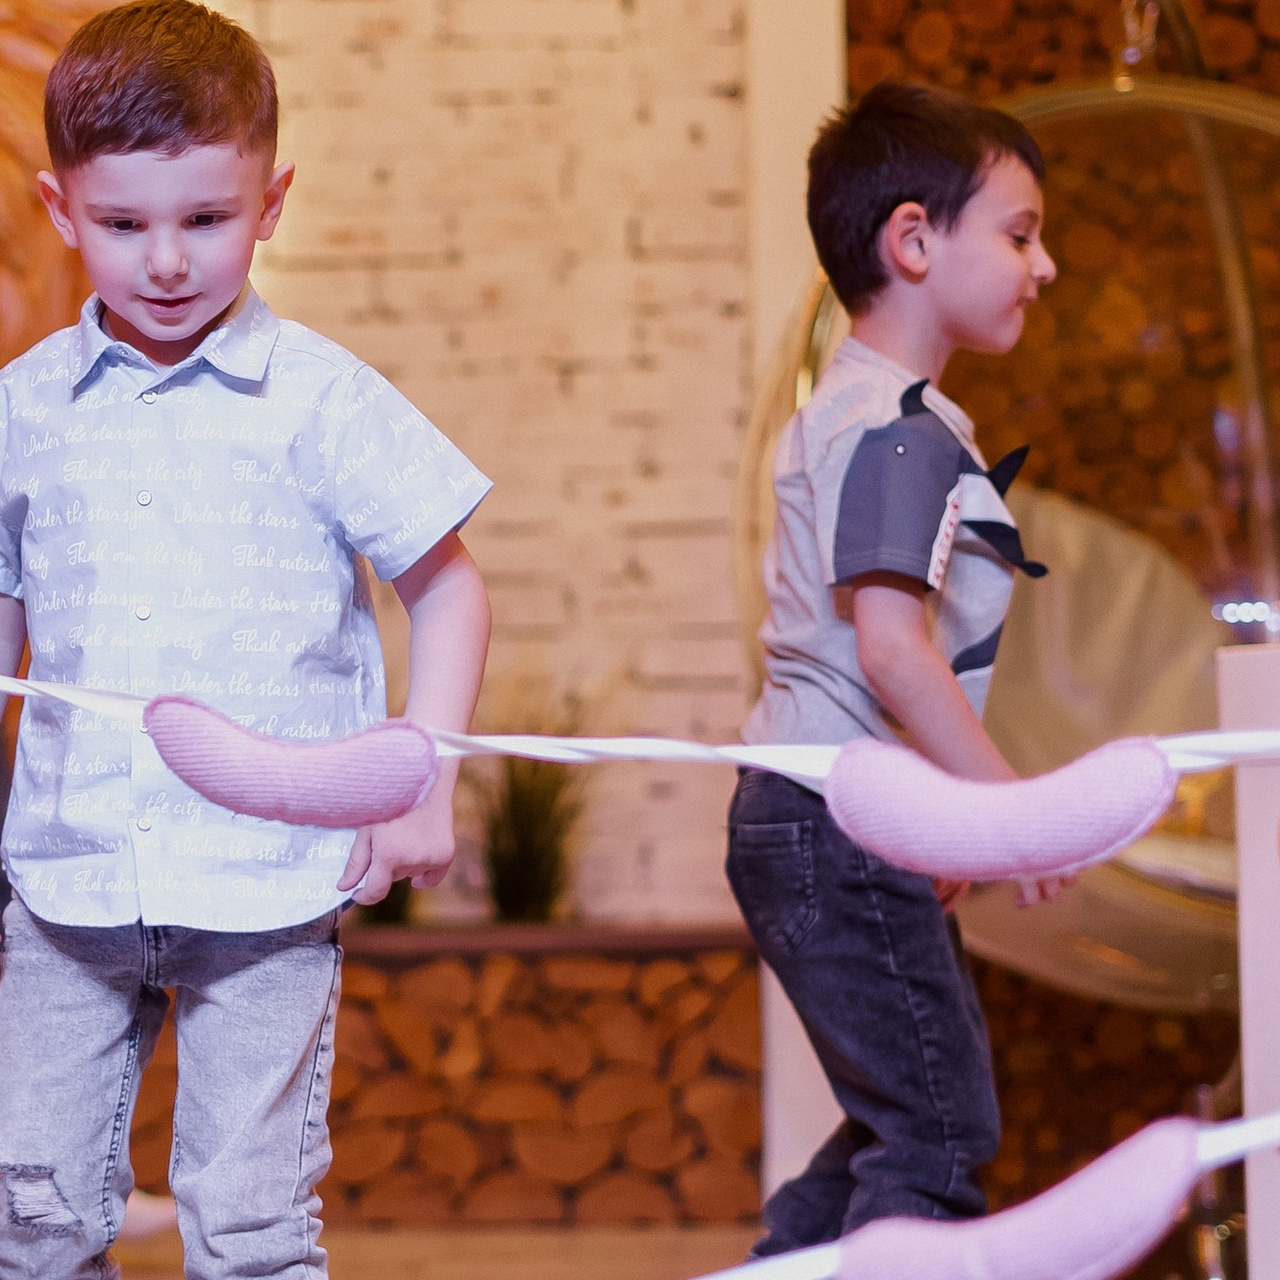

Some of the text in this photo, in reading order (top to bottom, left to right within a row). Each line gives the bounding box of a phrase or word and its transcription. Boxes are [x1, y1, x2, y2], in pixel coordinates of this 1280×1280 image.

[23, 430, 61, 458] Under
[64, 424, 87, 445] the
[174, 417, 225, 441] Under
[229, 421, 256, 442] the
[260, 426, 305, 447] stars
[63, 458, 112, 484] Think
[146, 458, 171, 482] the
[174, 460, 207, 492] city
[232, 458, 283, 485] Think
[24, 506, 64, 531] Under
[65, 499, 85, 524] the
[172, 500, 225, 524] Under
[228, 500, 255, 525] the
[257, 505, 301, 530] stars
[67, 539, 108, 566] Think
[144, 541, 172, 565] the
[173, 544, 207, 576] city
[232, 542, 277, 569] Think
[279, 550, 331, 573] outside
[33, 589, 68, 614] Under
[69, 584, 86, 608] the
[172, 586, 226, 611] Under
[229, 586, 256, 611] the
[258, 589, 301, 613] stars
[69, 623, 107, 650] Think
[144, 624, 170, 648] the
[173, 630, 207, 660] city
[231, 628, 281, 653] Think
[170, 669, 223, 693] Under
[227, 670, 255, 696] the
[257, 674, 301, 698] stars
[69, 708, 106, 733] Think
[281, 717, 331, 739] outside
[62, 752, 83, 776] the
[84, 754, 131, 776] stars
[145, 791, 170, 815] the
[173, 796, 207, 826] city
[229, 836, 254, 860] the
[257, 842, 296, 863] stars
[306, 837, 350, 860] Home
